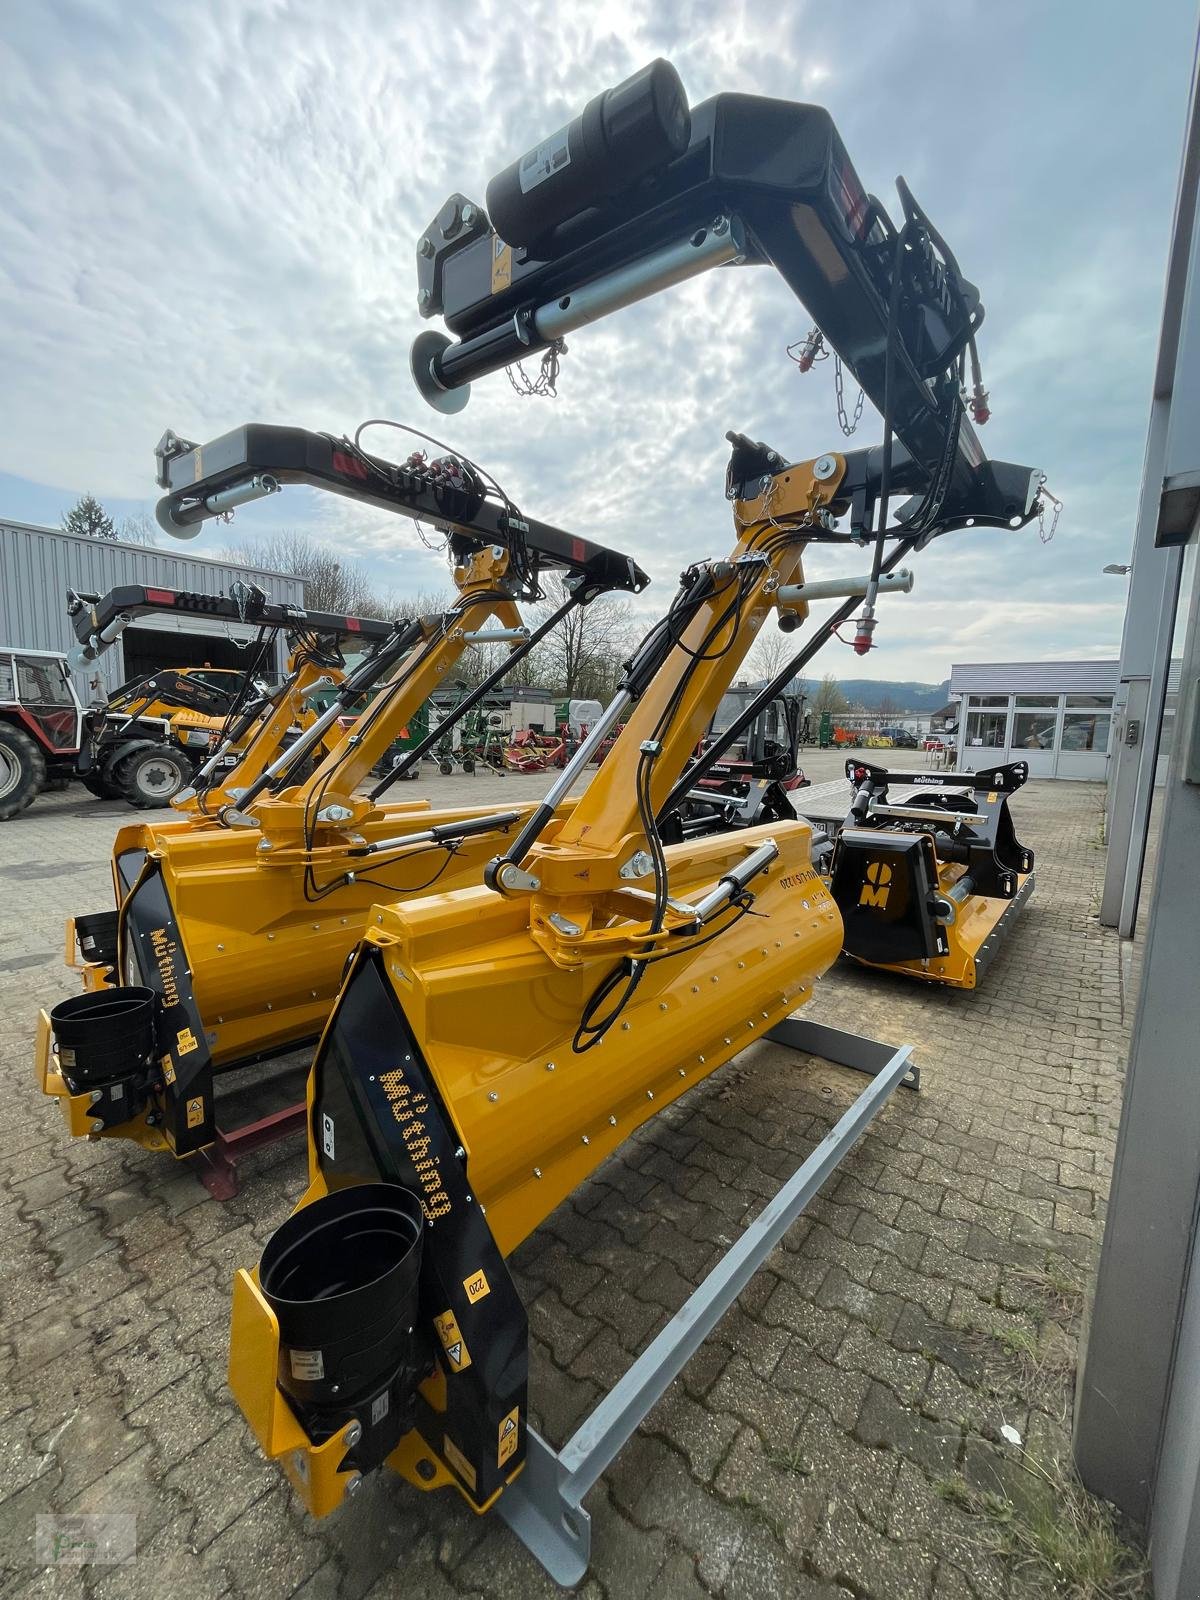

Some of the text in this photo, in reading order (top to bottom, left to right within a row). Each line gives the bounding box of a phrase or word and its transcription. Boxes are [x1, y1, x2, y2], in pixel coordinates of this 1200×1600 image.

[913, 775, 944, 785] Müthing
[149, 928, 180, 1008] Müthing
[378, 1068, 452, 1220] Müthing
[468, 1277, 485, 1296] 220
